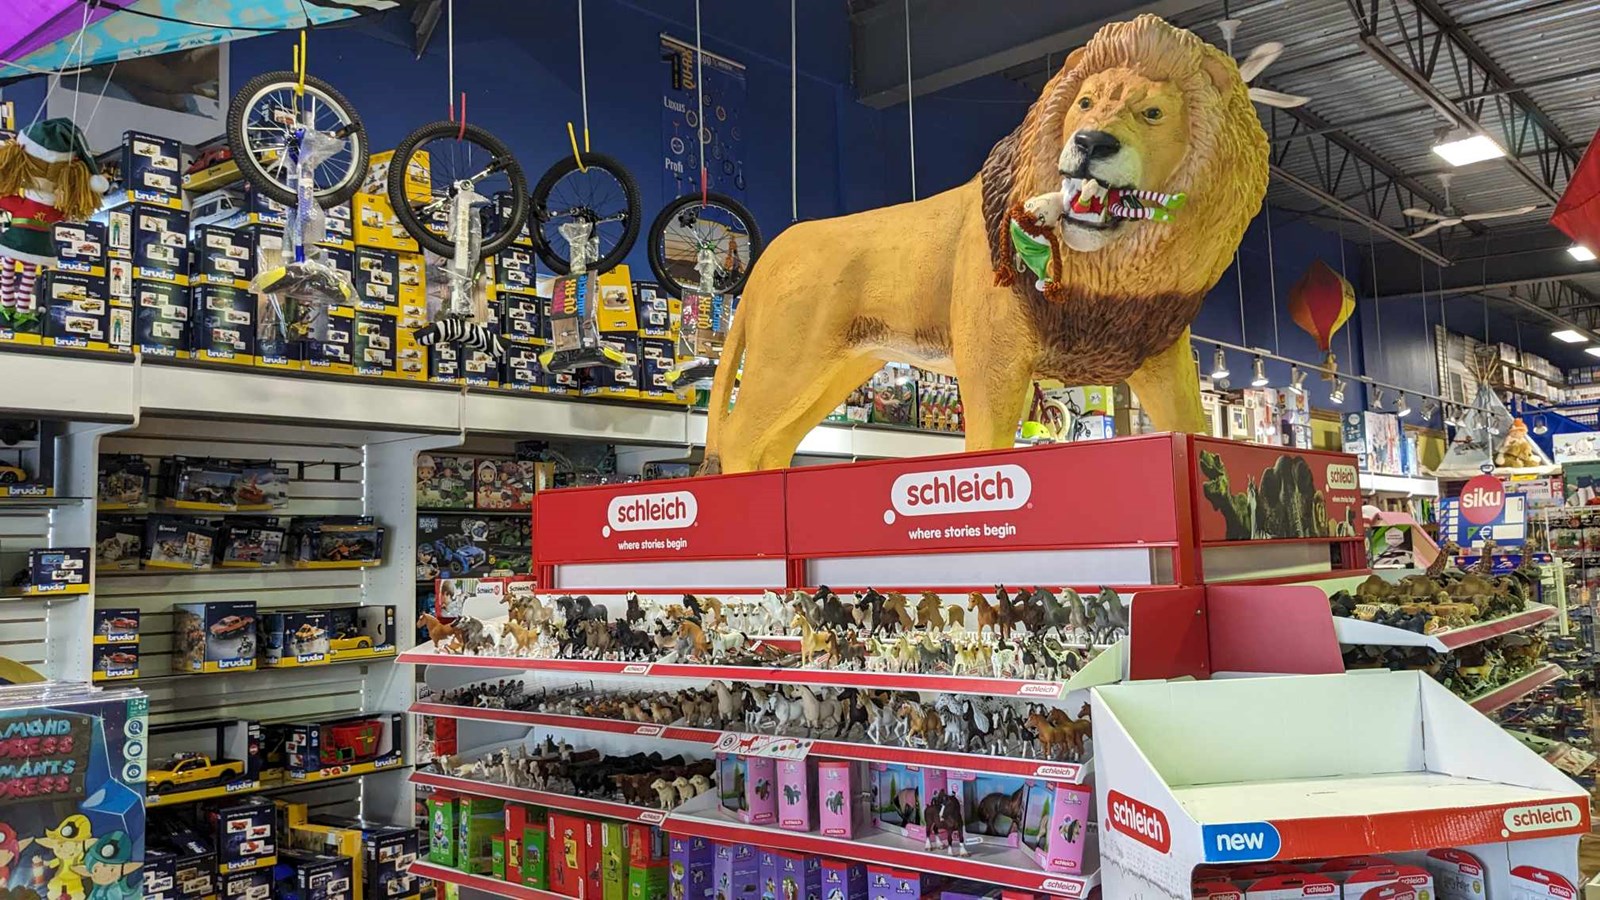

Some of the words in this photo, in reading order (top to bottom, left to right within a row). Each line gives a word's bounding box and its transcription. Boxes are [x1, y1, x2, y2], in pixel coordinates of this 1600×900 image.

[664, 96, 686, 113] Luxus
[665, 157, 683, 173] Profi
[134, 190, 168, 204] bruder
[57, 260, 90, 272] bruder
[140, 267, 174, 280] bruder
[208, 273, 234, 284] bruder
[564, 279, 577, 314] QU-AX
[698, 296, 711, 328] QU-AX
[55, 336, 88, 348] bruder
[141, 344, 175, 358] bruder
[208, 348, 234, 359] bruder
[263, 356, 288, 365] bruder
[310, 358, 330, 367] bruder
[358, 366, 383, 376] bruder
[1330, 467, 1353, 484] schleich
[9, 486, 46, 496] bruder
[907, 471, 1014, 506] schleich
[1463, 488, 1501, 508] siku
[618, 496, 686, 522] schleich
[908, 528, 942, 540] where
[944, 524, 980, 538] stories
[984, 523, 1016, 539] begin
[618, 540, 640, 550] where
[641, 539, 665, 550] stories
[666, 537, 688, 550] begin
[38, 583, 66, 592] bruder
[108, 634, 136, 643] bruder
[219, 658, 252, 668] bruder
[298, 654, 324, 663] bruder
[107, 669, 134, 678] bruder
[1025, 685, 1054, 693] schleich
[0, 718, 71, 739] MOND
[374, 756, 399, 768] bruder
[1041, 767, 1071, 776] schleich
[226, 780, 253, 792] bruder
[1113, 800, 1164, 843] schleich
[1513, 806, 1573, 826] schleich
[1216, 832, 1264, 852] new
[228, 858, 257, 870] bruder
[1047, 880, 1077, 892] schleich
[1402, 876, 1425, 884] schleich
[1551, 886, 1570, 896] schleich
